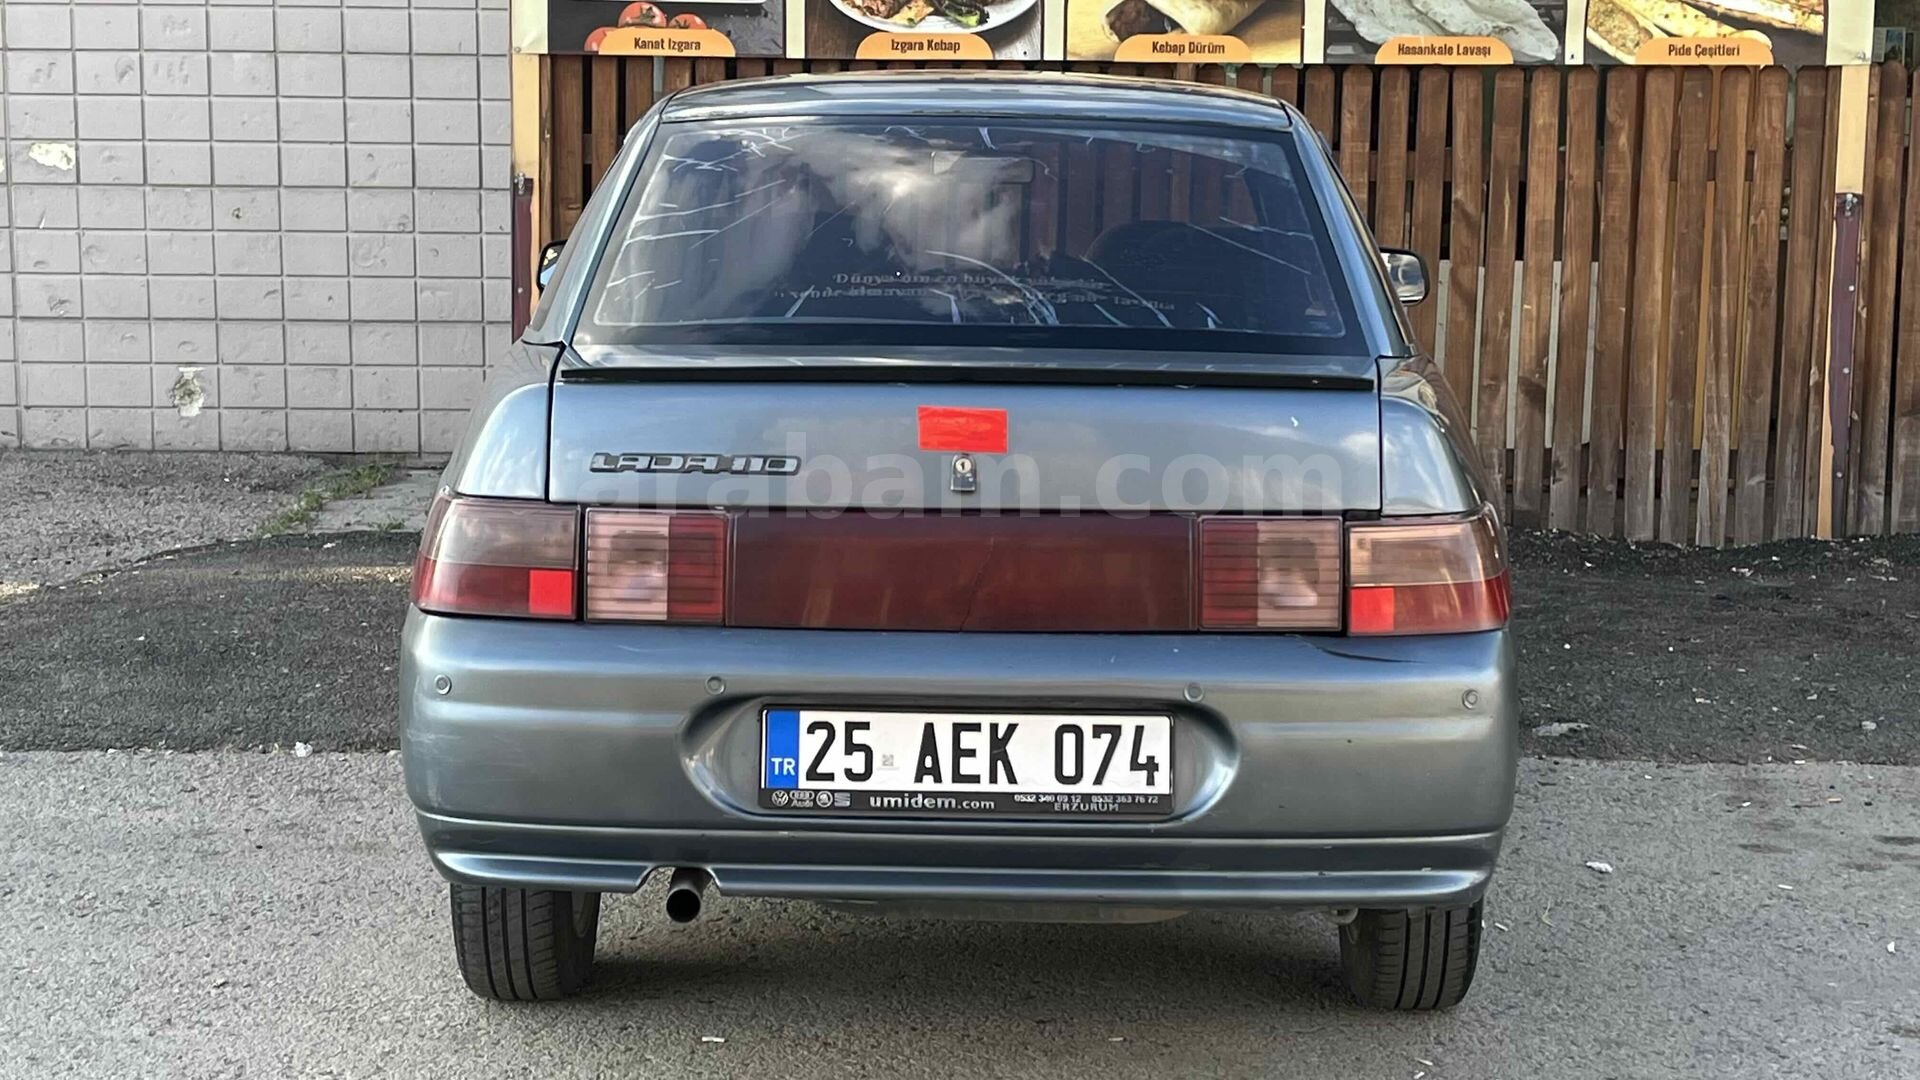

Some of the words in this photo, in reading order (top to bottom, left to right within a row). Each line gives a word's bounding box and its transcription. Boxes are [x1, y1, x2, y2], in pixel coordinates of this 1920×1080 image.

[634, 36, 665, 50] Kanat
[667, 37, 702, 53] Izgara
[891, 38, 924, 54] Izgara
[927, 39, 961, 54] Kebap
[1152, 41, 1186, 56] Kebap
[1188, 41, 1226, 55] Dürüm
[1397, 43, 1454, 56] Hasankale
[1456, 43, 1491, 58] Lavaşı
[1668, 43, 1692, 56] Pide
[1694, 43, 1740, 58] Çeşitleri
[590, 452, 720, 473] LADA
[730, 455, 801, 475] 110
[805, 720, 874, 783] 25
[914, 722, 1019, 785] AEK
[1054, 724, 1160, 786] 074
[771, 757, 796, 776] TR
[869, 792, 995, 810] umidem.com
[1054, 802, 1120, 812] ERZURUM
